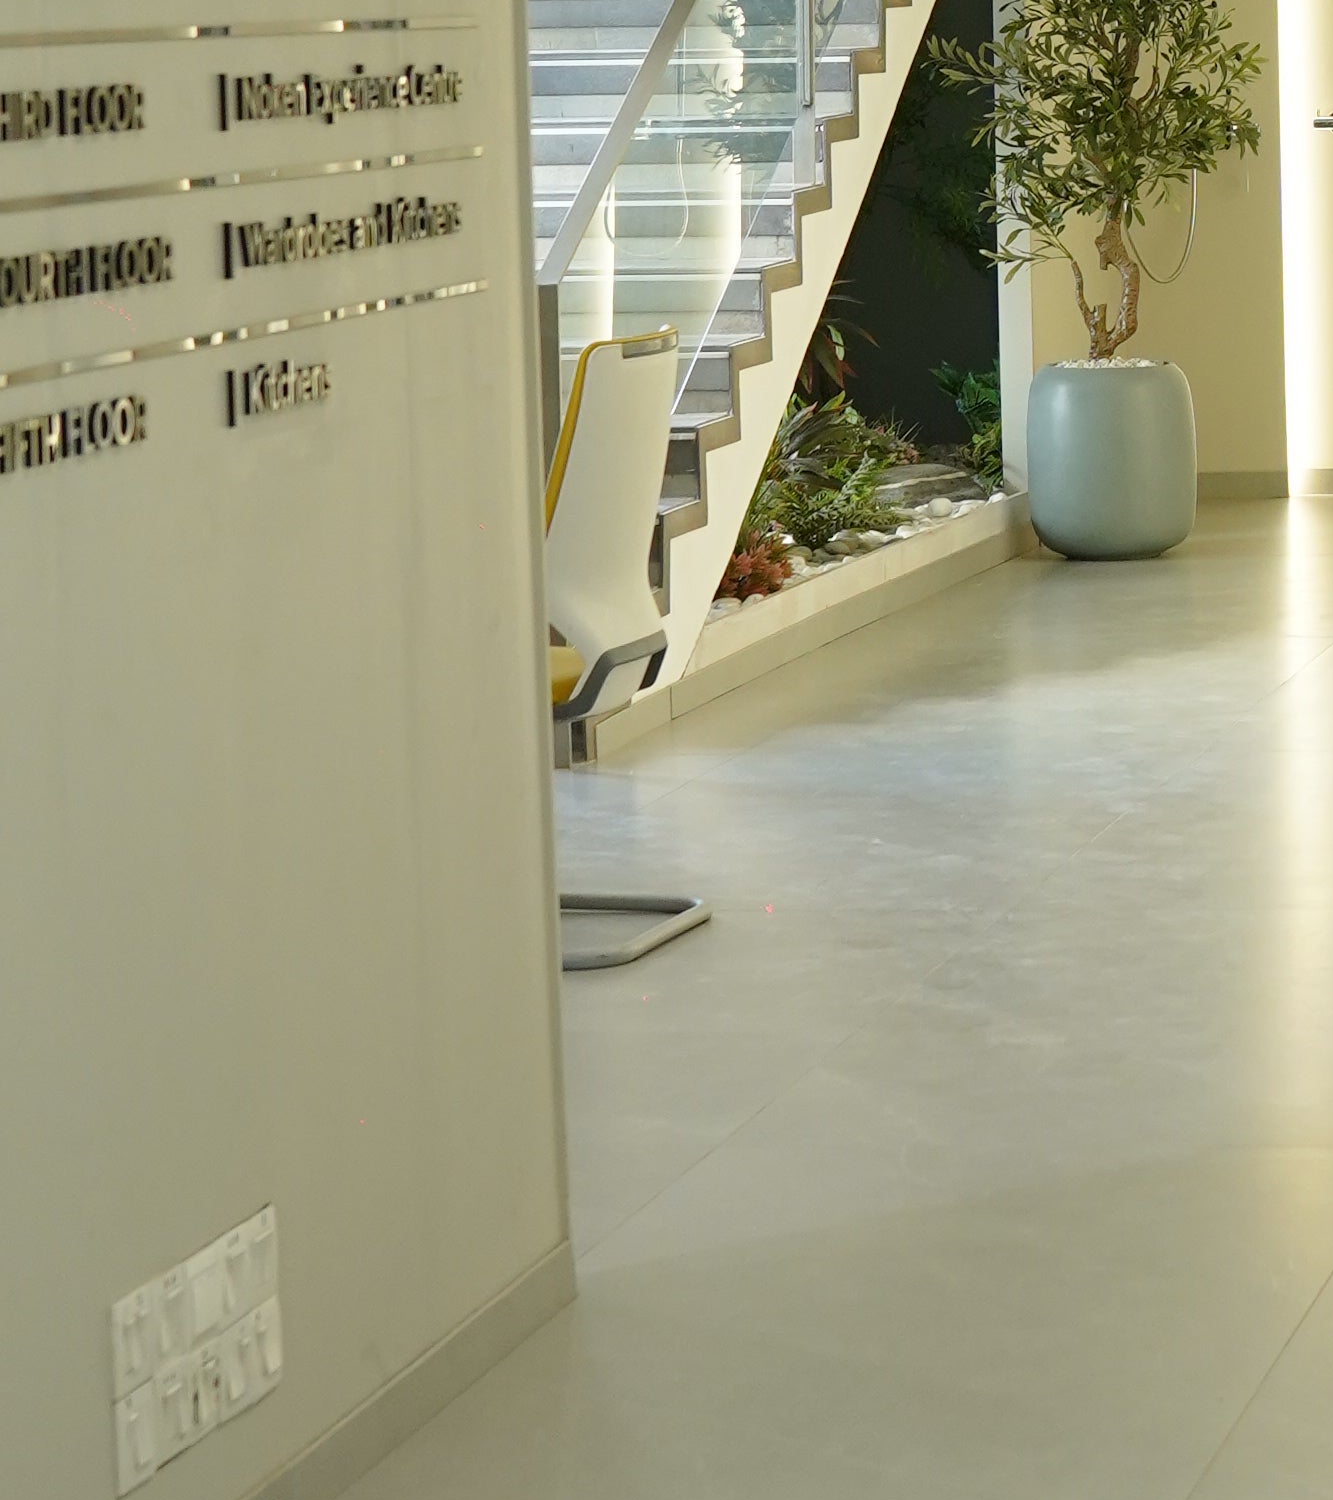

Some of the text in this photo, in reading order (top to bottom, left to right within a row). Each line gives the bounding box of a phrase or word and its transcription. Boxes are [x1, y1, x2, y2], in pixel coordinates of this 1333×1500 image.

[57, 84, 147, 137] FLOOR
[235, 72, 306, 121] Noken
[303, 64, 409, 125] Experience
[87, 236, 175, 294] FLOOR
[237, 212, 348, 268] Wardrobes
[347, 202, 387, 251] and
[386, 196, 463, 245] Kitchens
[60, 395, 147, 458] FLOOR
[242, 359, 333, 416] Kitchens
